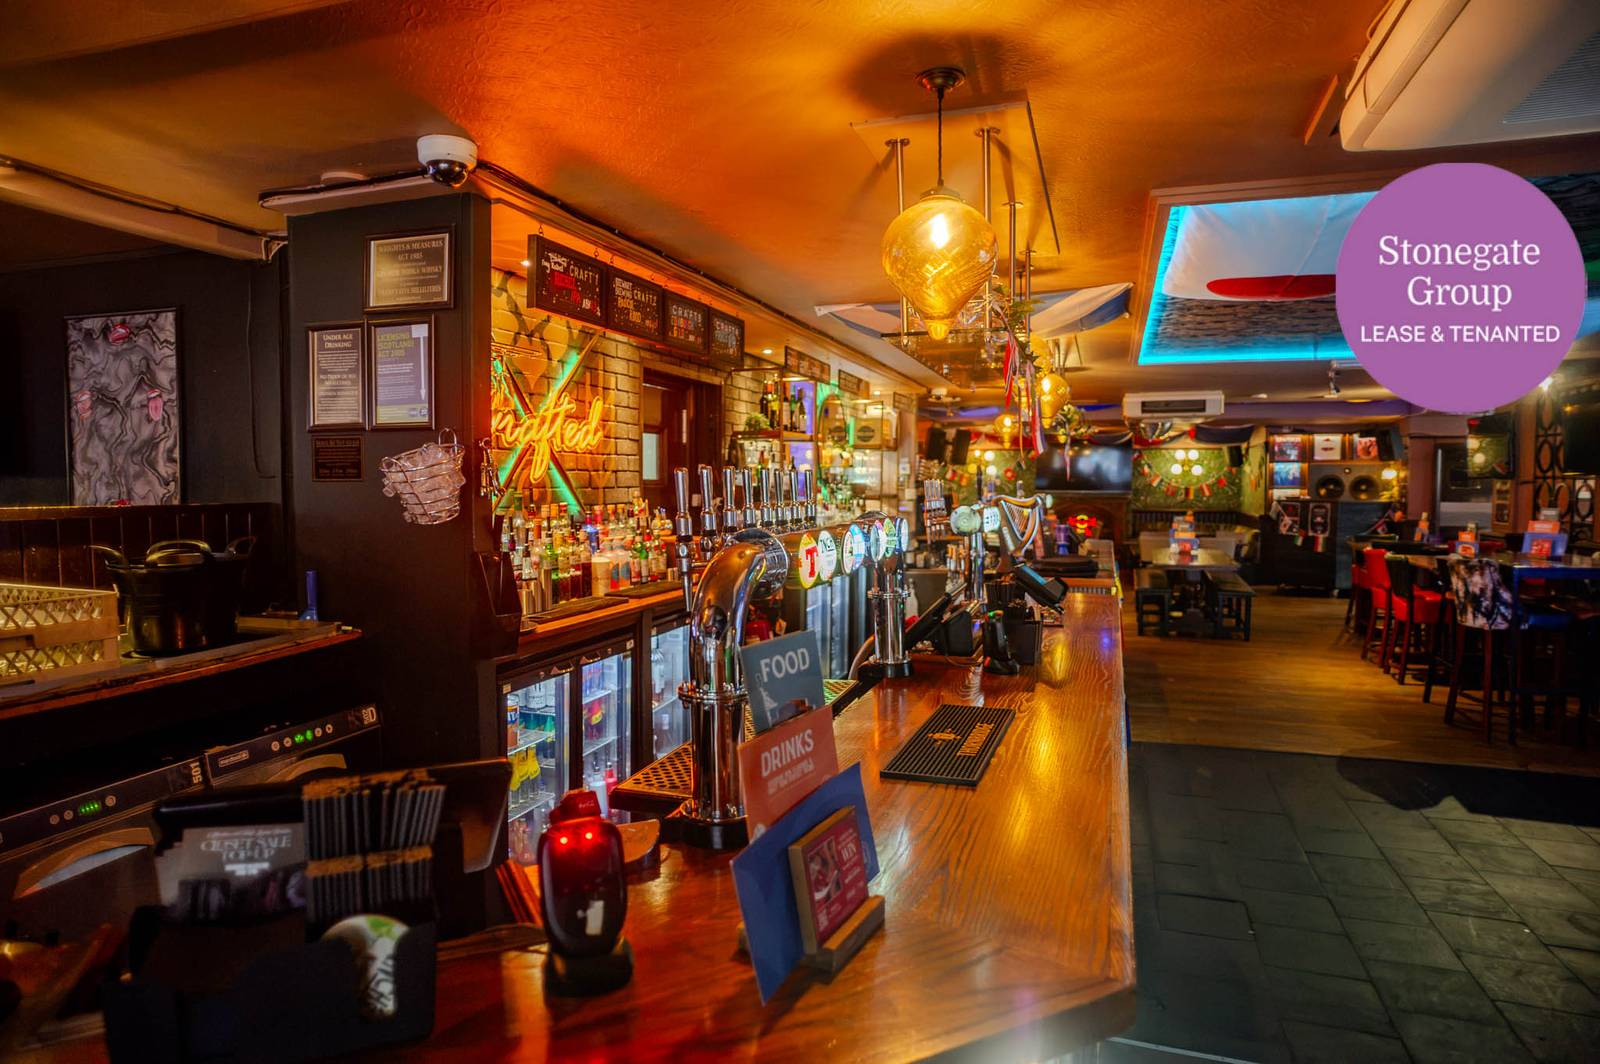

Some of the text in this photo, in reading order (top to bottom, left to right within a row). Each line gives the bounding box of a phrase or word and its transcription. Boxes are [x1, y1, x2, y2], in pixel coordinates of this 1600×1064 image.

[569, 264, 593, 284] CRAFT
[805, 545, 819, 578] T
[759, 647, 810, 683] FOOD
[760, 728, 815, 778] DRINKS
